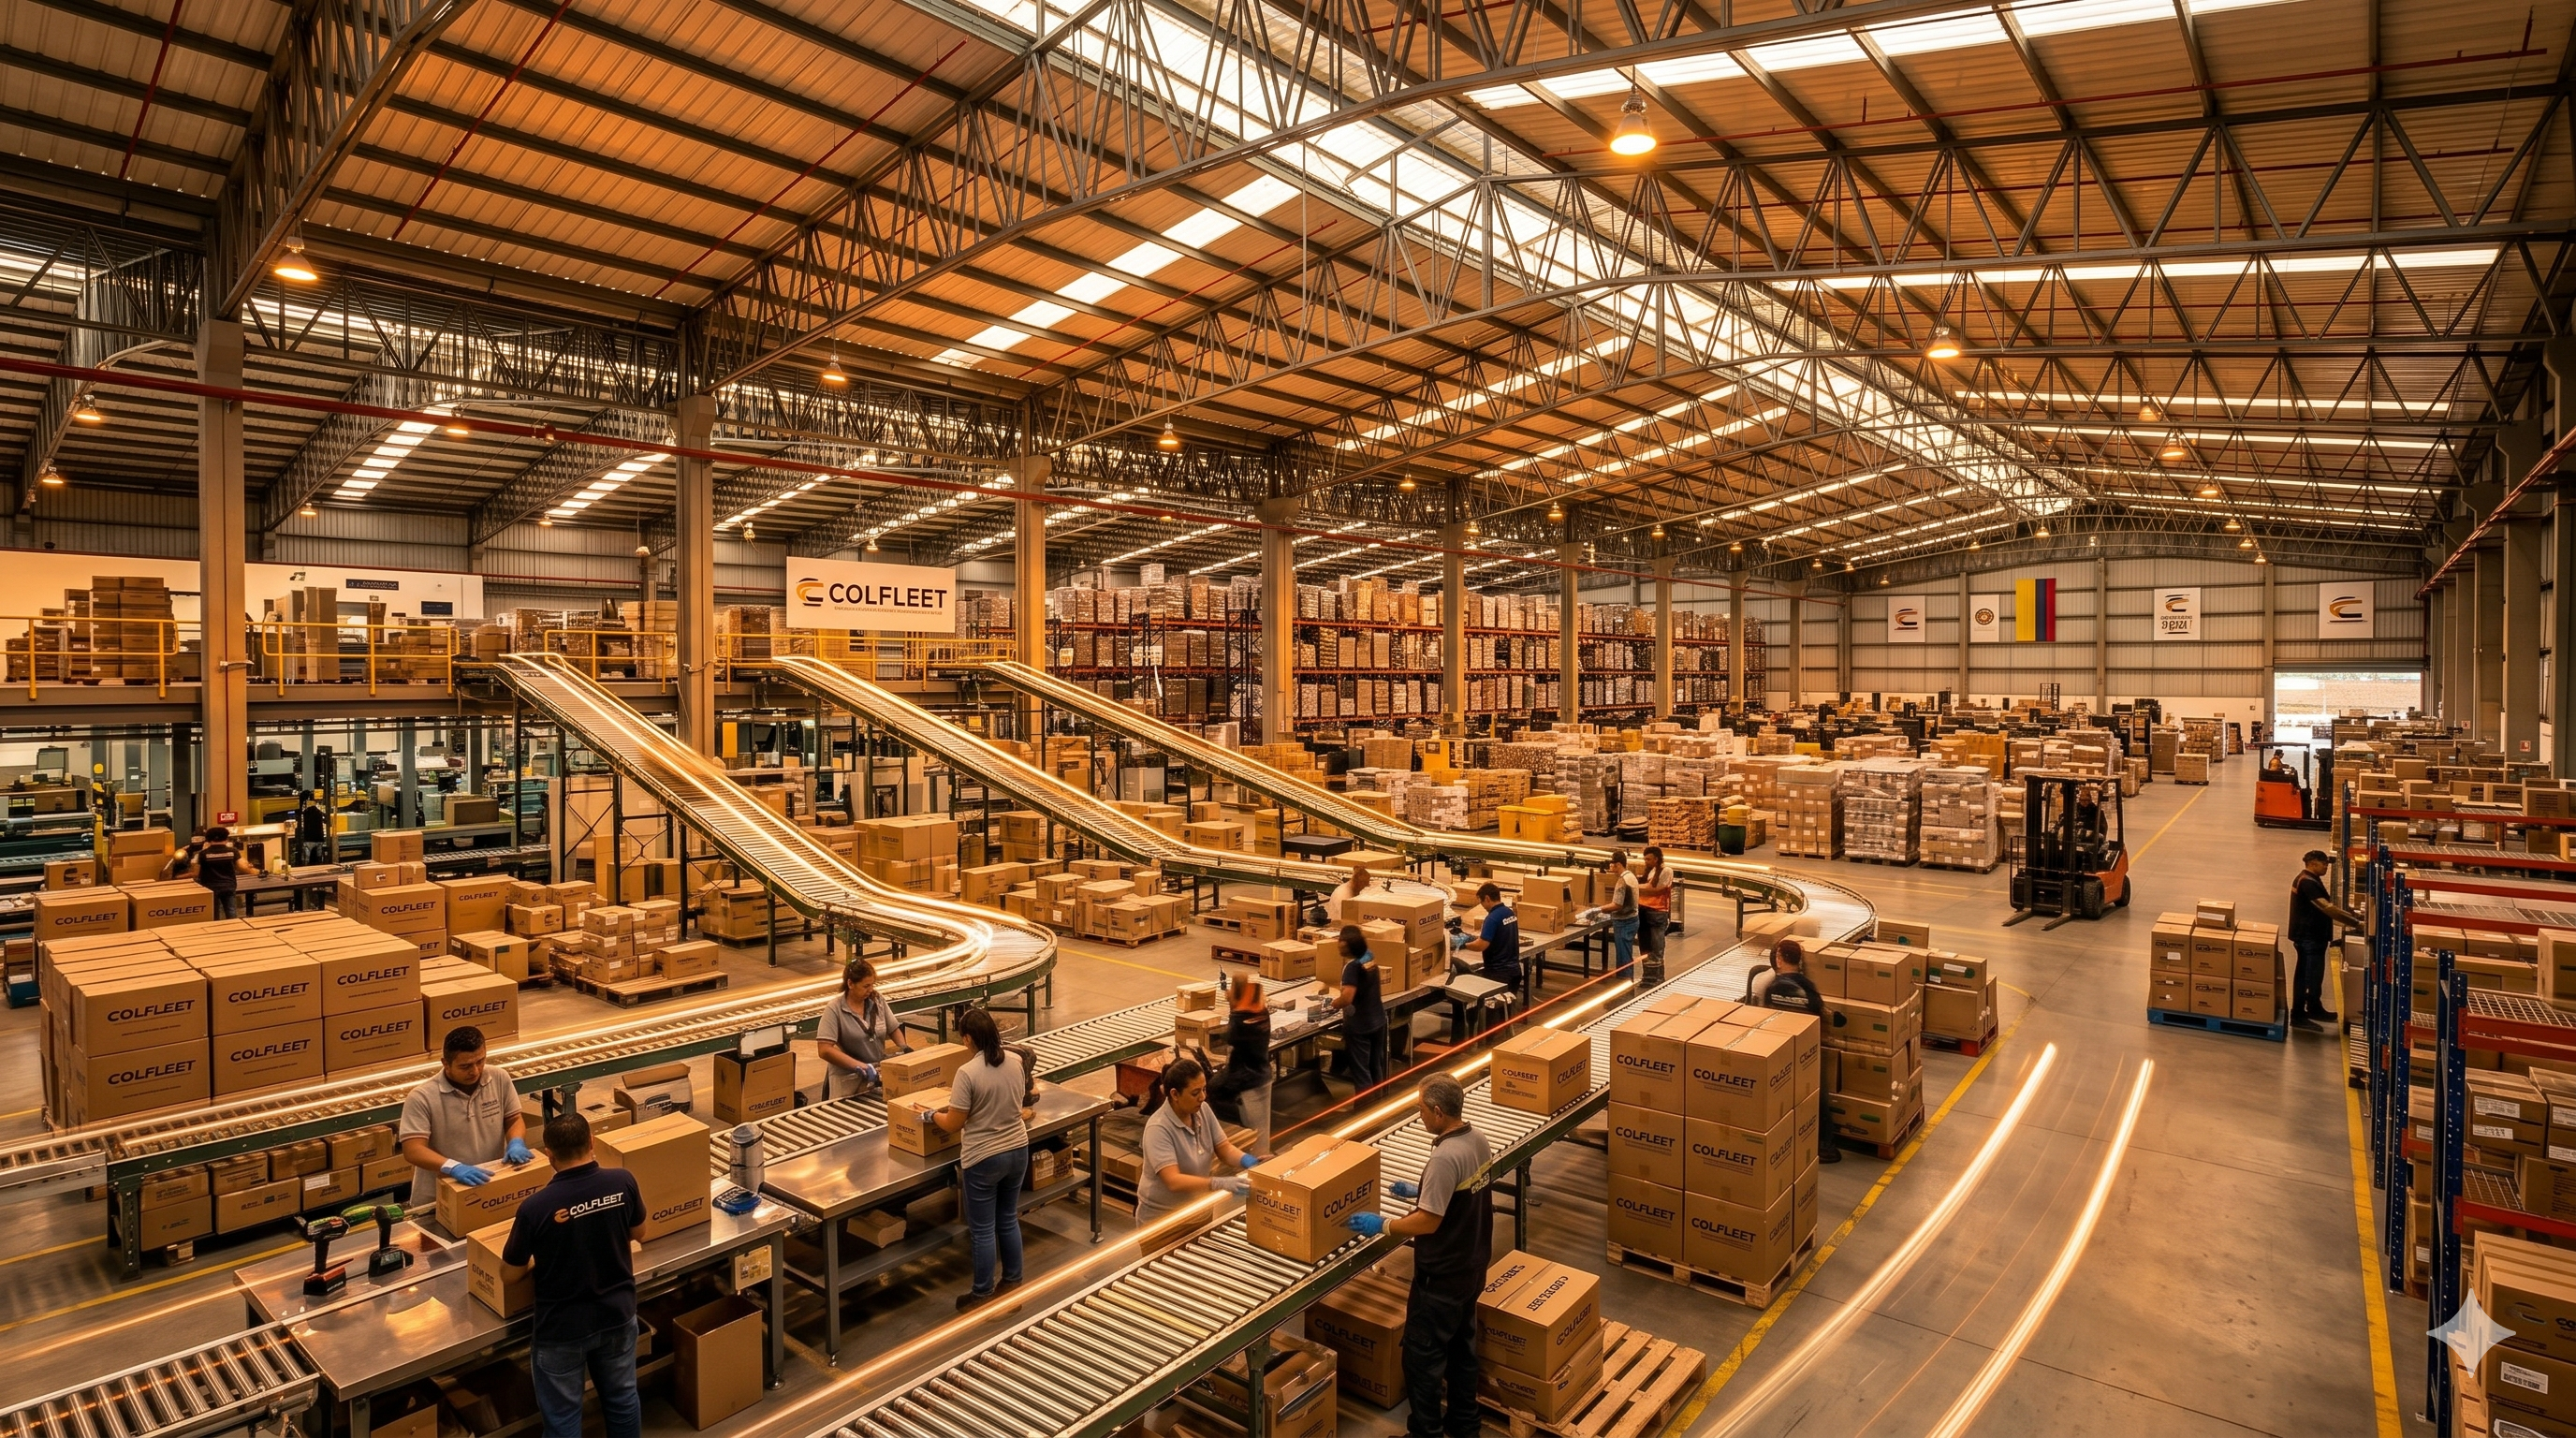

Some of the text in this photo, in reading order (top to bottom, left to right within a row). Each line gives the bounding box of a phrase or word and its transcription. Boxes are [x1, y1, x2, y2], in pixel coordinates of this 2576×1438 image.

[829, 583, 947, 609] COLFLEET
[55, 912, 118, 926] COLFLEET
[148, 904, 207, 917] COLFLEET
[381, 901, 436, 915] COLFLEET
[337, 965, 410, 986] COLFLEET
[227, 982, 310, 1004] COLFLEET
[107, 999, 195, 1022] COLFLEET
[442, 1000, 508, 1020] COLFLEET
[340, 1020, 413, 1041] COLFLEET
[229, 1038, 311, 1062] COLFLEET
[108, 1059, 196, 1085] COLFLEET
[1616, 1054, 1676, 1074] COLFLEET
[1693, 1068, 1757, 1089] COLFLEET
[1615, 1126, 1676, 1148] COLFLEET
[1692, 1143, 1757, 1167] COLFLEET
[570, 1192, 624, 1216] COLFLEET
[1324, 1179, 1374, 1218] COLFLEET
[1616, 1197, 1676, 1221] COLFLEET
[1691, 1217, 1756, 1243] COLFLEET
[1314, 1318, 1377, 1350] COLFLEET
